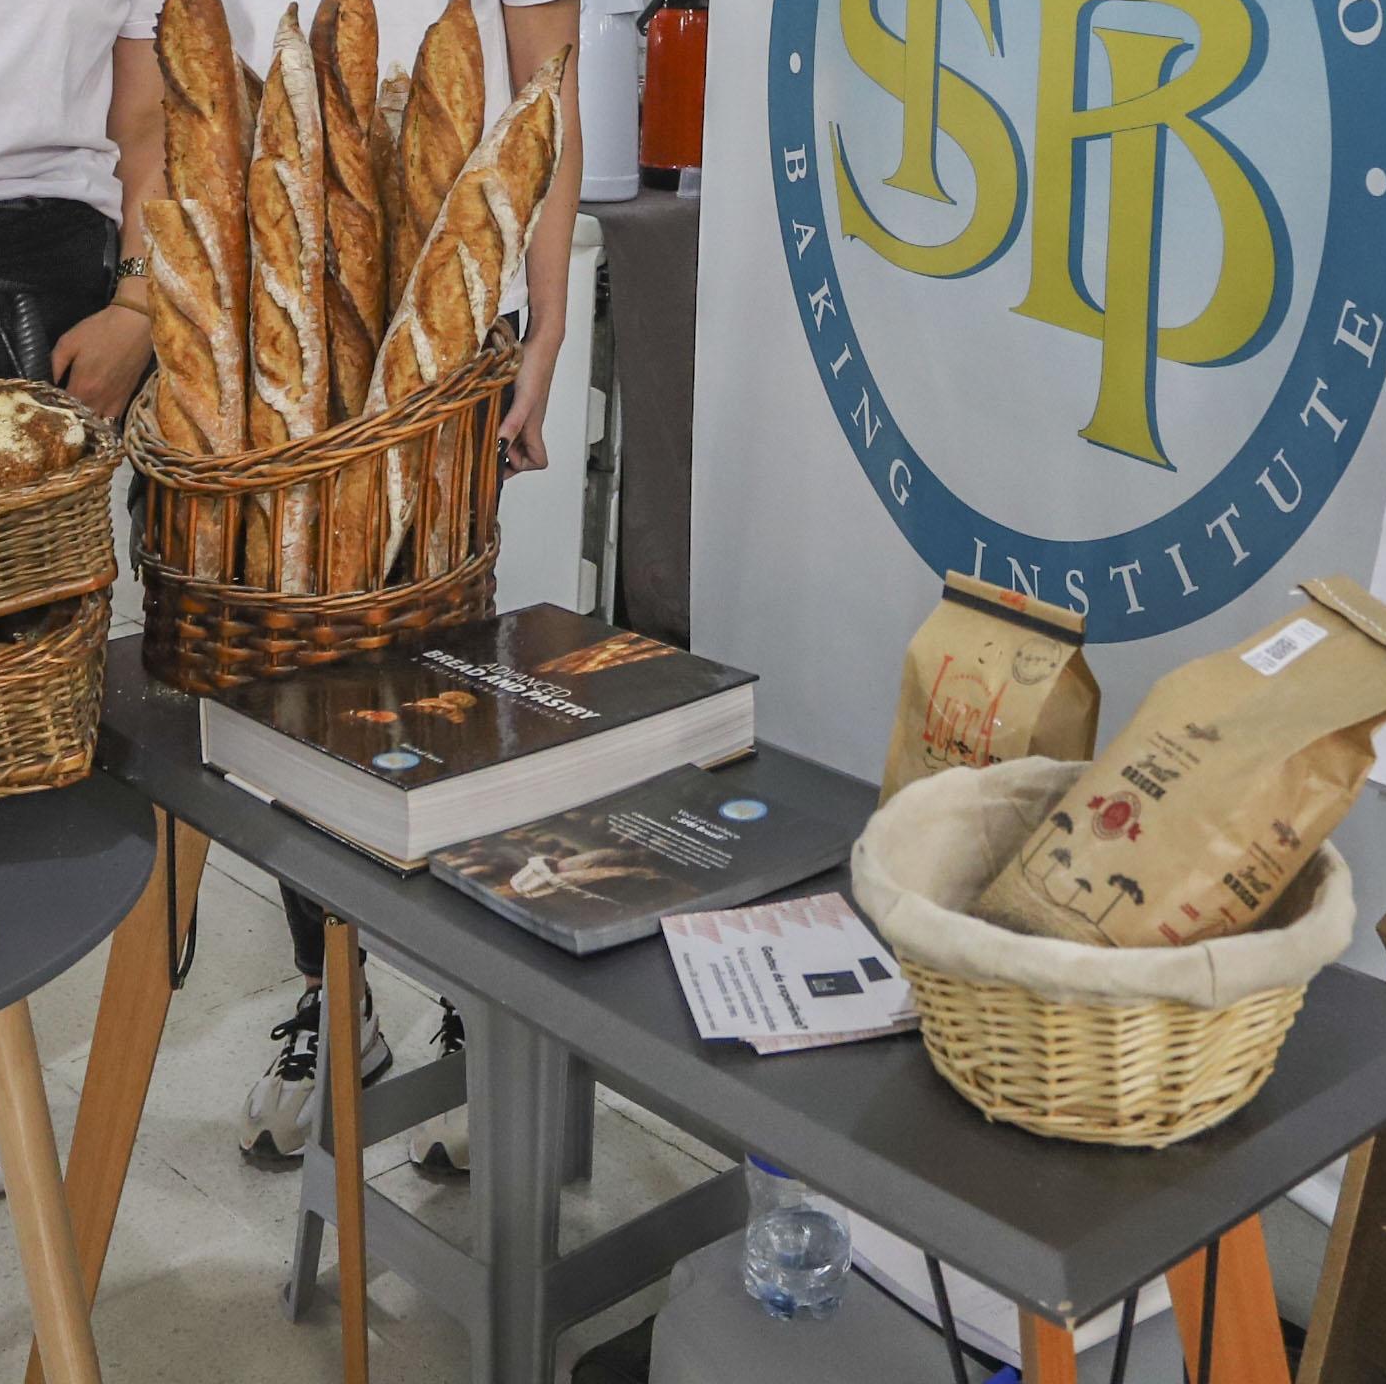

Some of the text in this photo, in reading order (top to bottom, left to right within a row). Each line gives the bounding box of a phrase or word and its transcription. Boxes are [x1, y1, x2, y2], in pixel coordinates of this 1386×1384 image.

[783, 143, 1385, 617] BAKING INSTITUTE
[422, 649, 601, 721] BREAD AND PASTRY
[481, 662, 572, 698] ADVANCED
